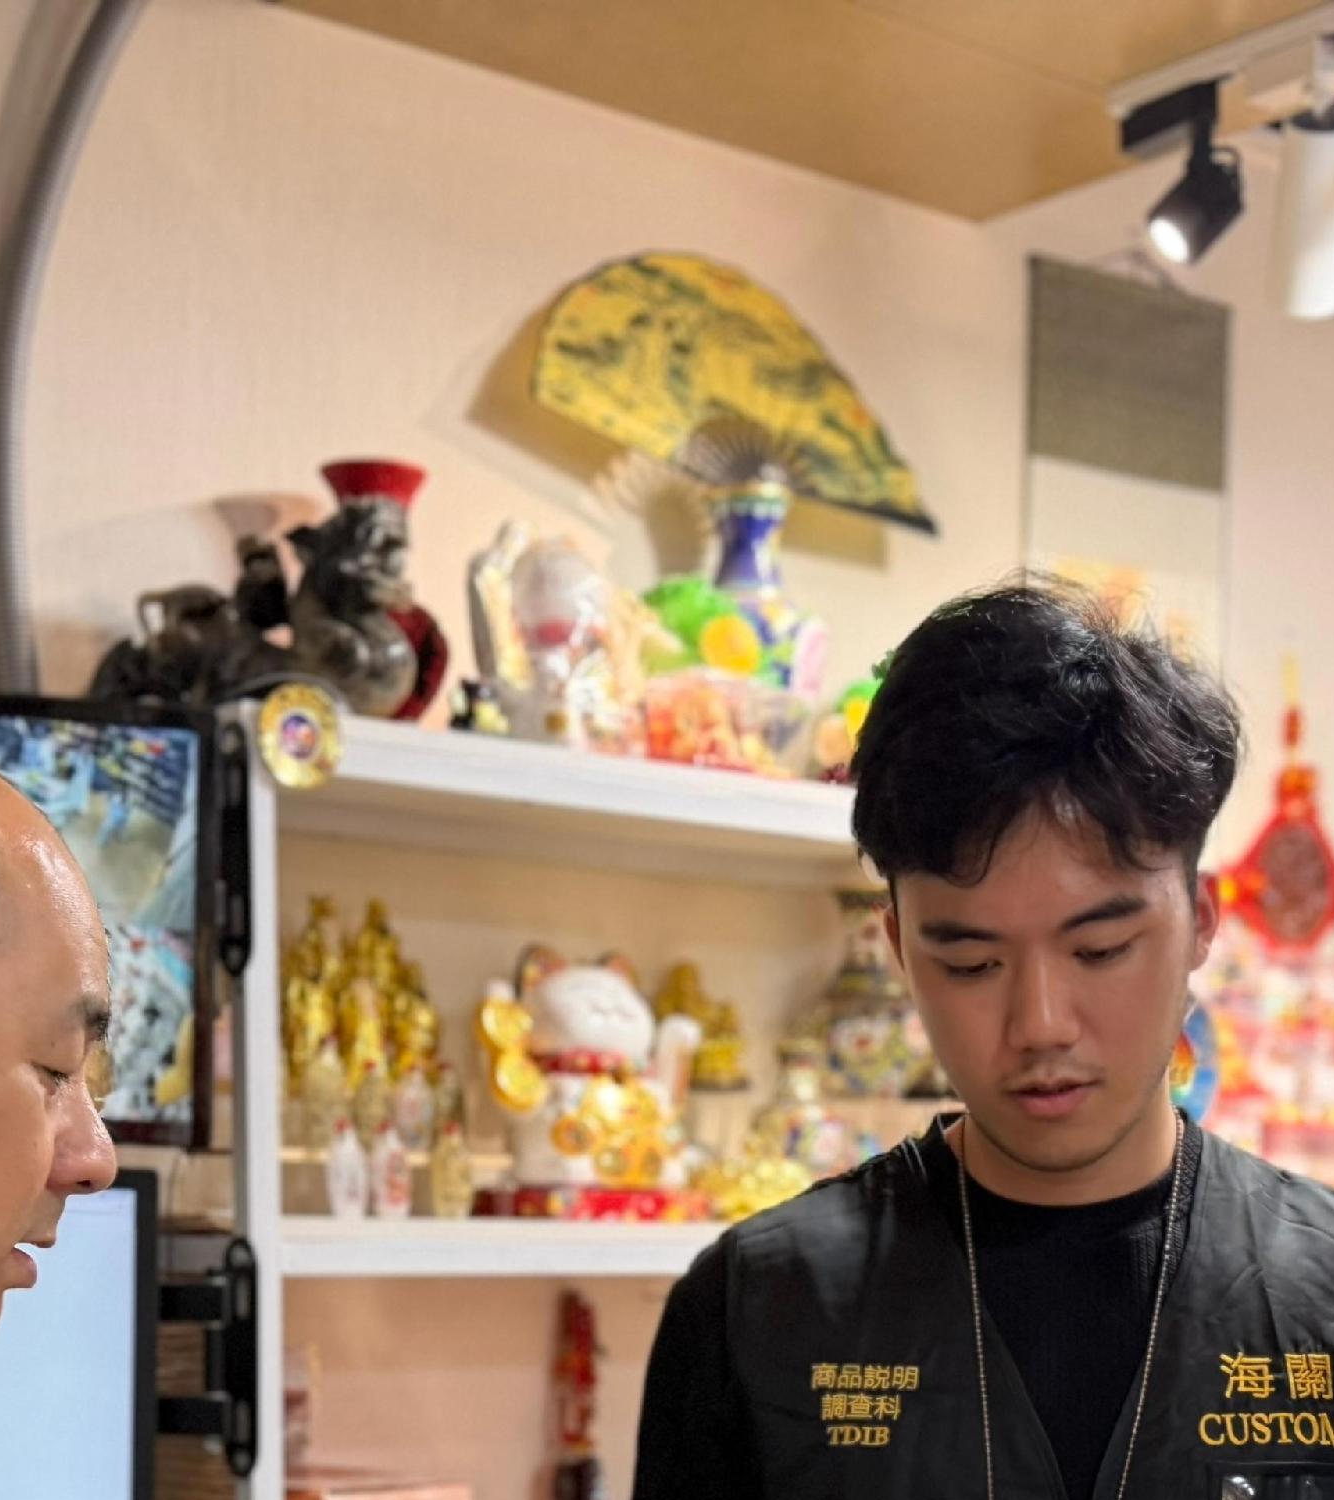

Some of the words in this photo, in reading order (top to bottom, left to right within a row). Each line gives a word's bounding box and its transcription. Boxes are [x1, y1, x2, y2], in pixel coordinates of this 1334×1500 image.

[1218, 1351, 1334, 1399] 海關
[821, 1393, 901, 1421] 調查科
[827, 1425, 891, 1446] TDIB
